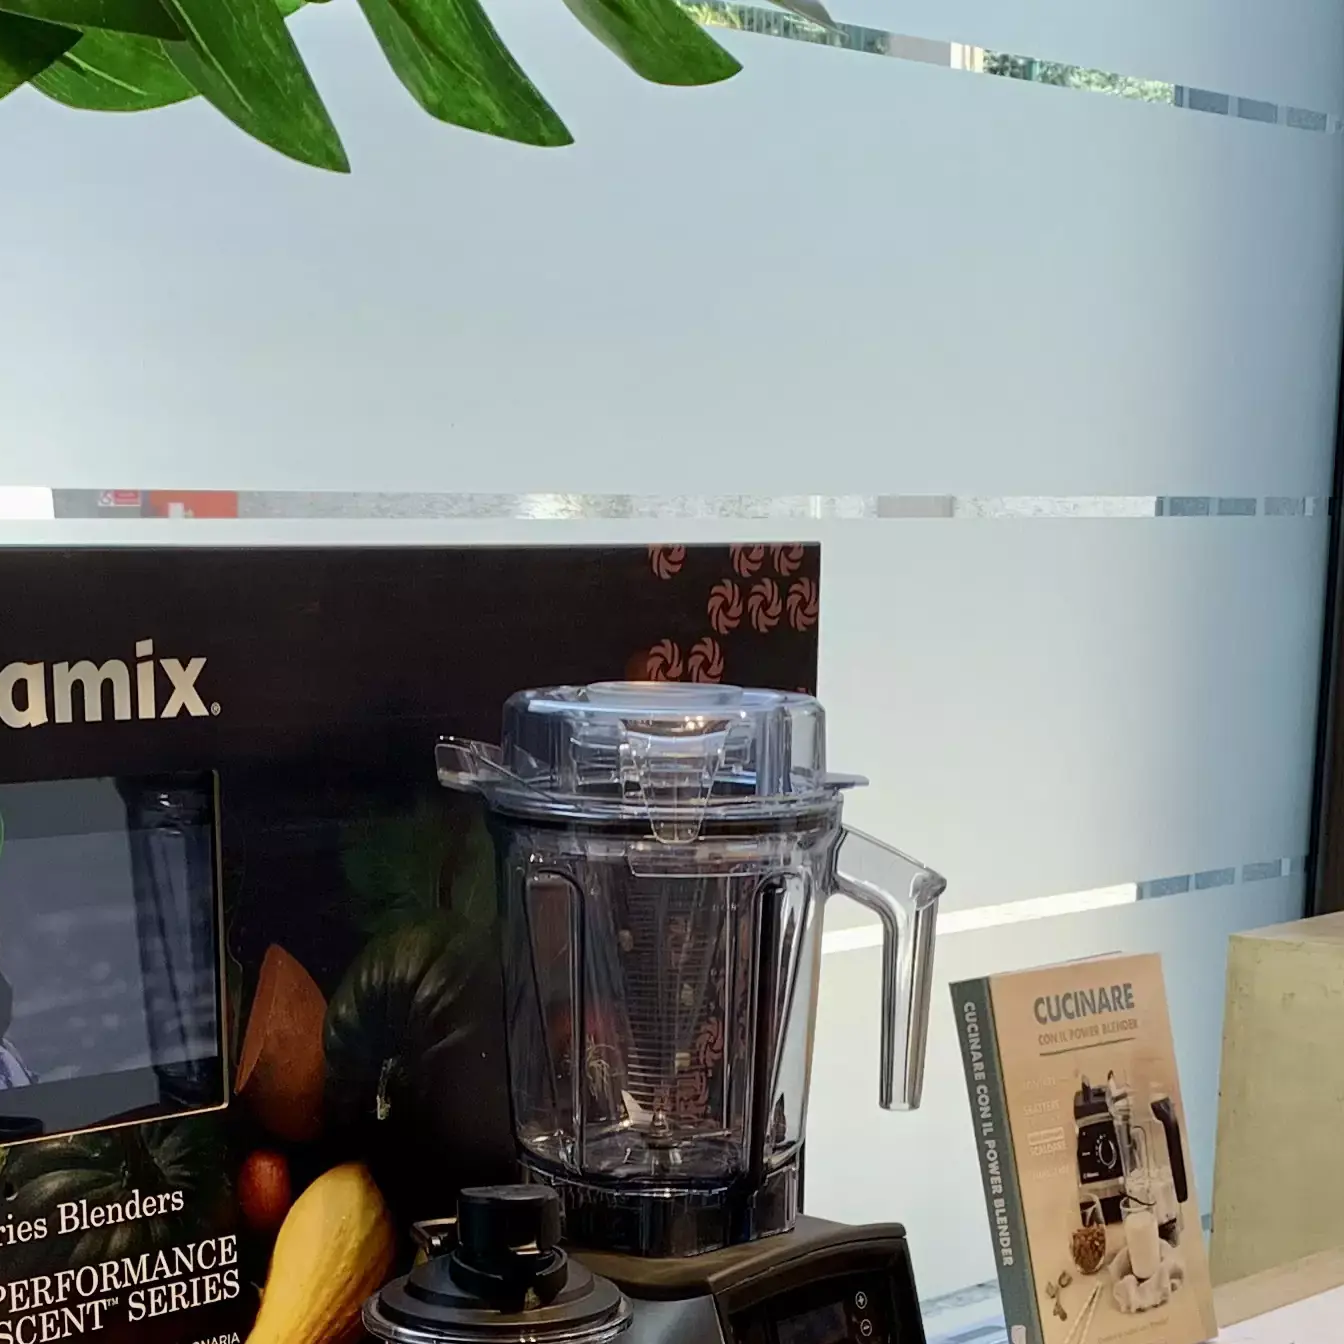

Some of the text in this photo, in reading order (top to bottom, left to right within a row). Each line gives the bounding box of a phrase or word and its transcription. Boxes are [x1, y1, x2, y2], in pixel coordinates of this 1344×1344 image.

[1034, 983, 1135, 1025] CUCINARE
[1038, 1031, 1058, 1046] CON
[1069, 1025, 1100, 1041] POWER
[1102, 1018, 1139, 1035] BLENDER
[964, 1001, 1013, 1267] CUCINARE CON IL POWER BLENDER
[57, 1188, 184, 1236] Blenders
[126, 1269, 241, 1323] SERIES
